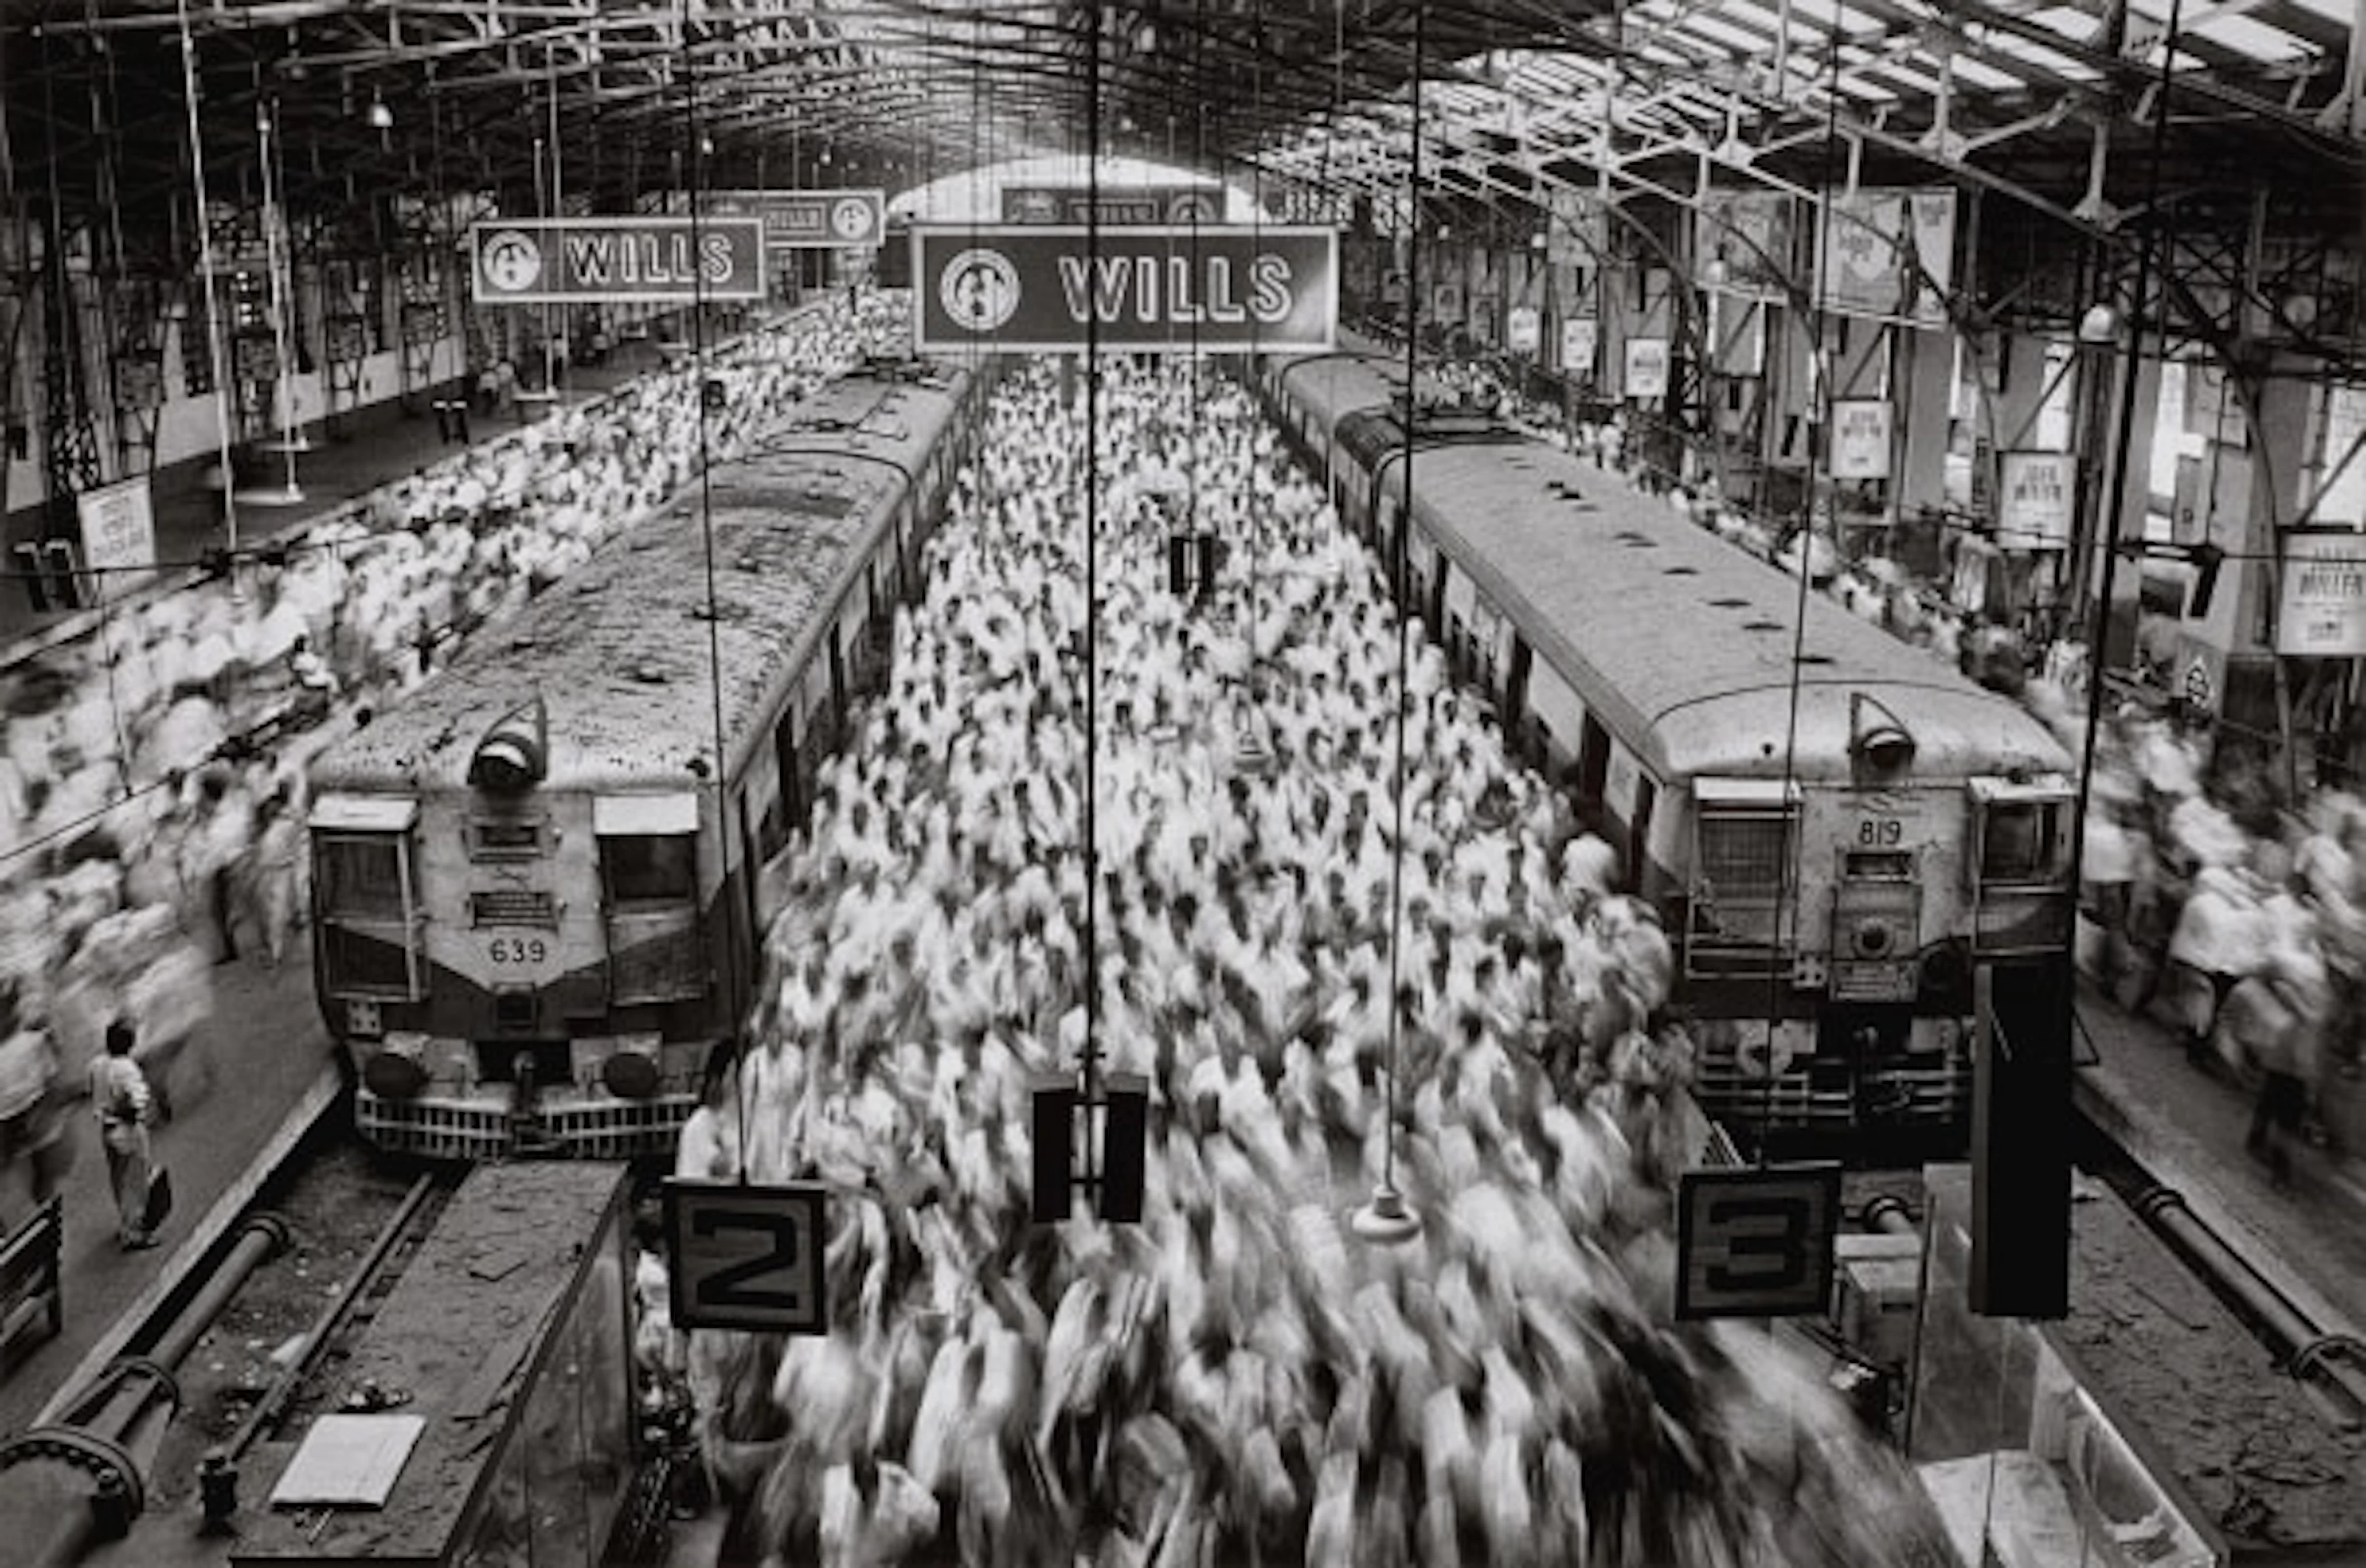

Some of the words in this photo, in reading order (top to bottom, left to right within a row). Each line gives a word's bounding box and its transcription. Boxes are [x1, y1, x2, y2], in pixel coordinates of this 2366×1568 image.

[566, 233, 733, 284] WILLS
[1056, 253, 1294, 323] WILLS
[1860, 821, 1901, 845] 819
[490, 938, 545, 962] 639
[692, 1208, 798, 1309] 2
[1707, 1196, 1810, 1291] 3
